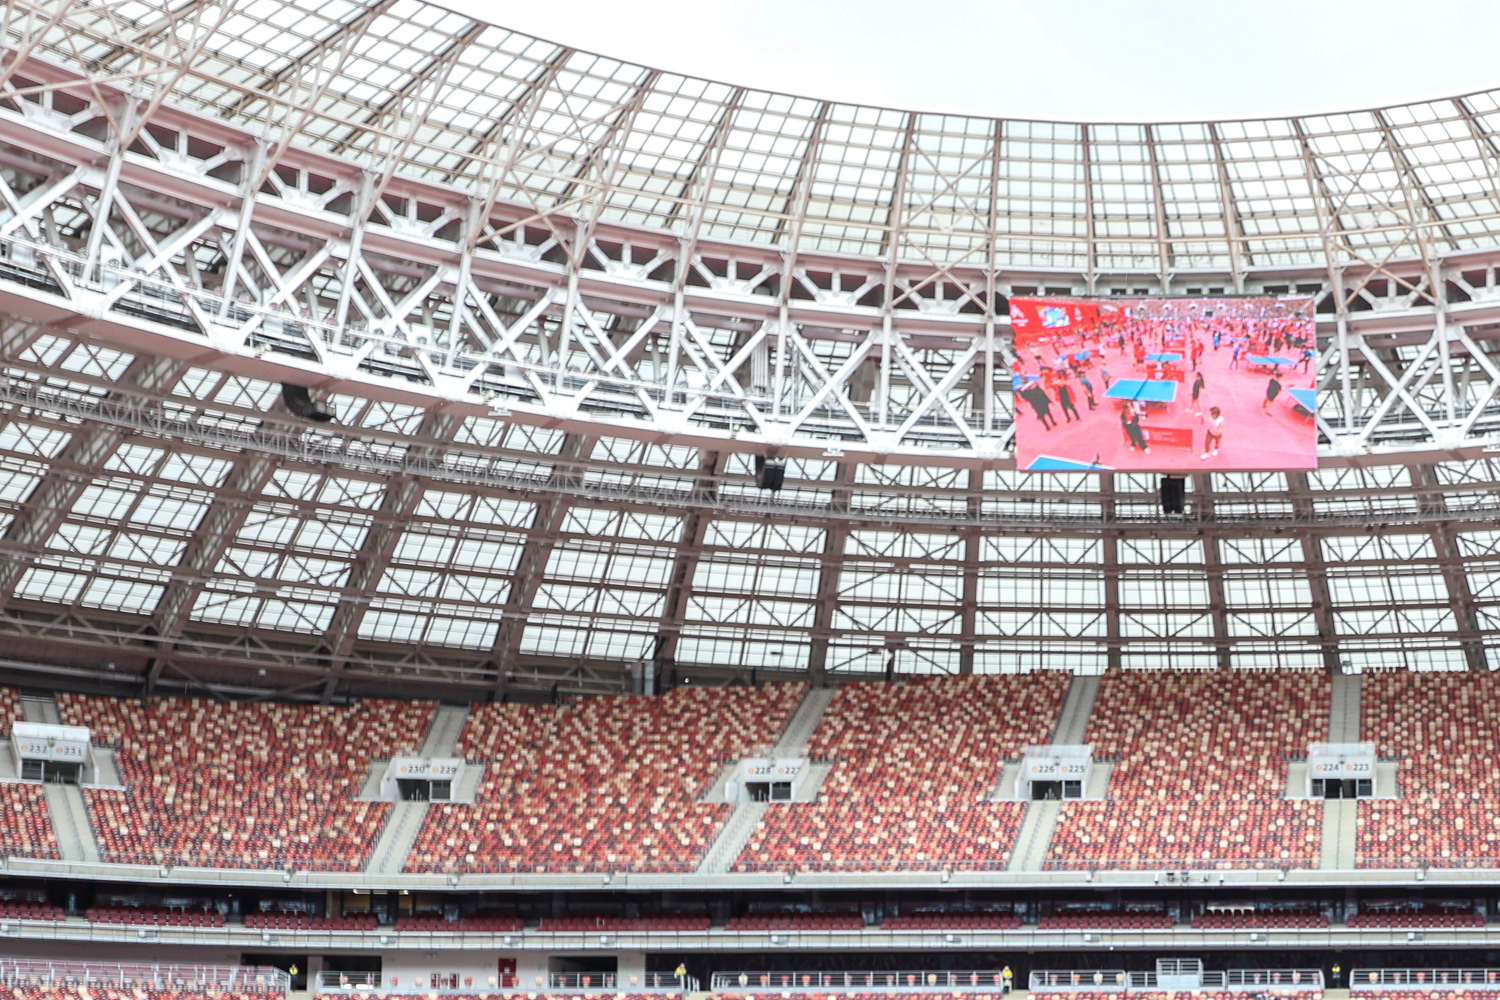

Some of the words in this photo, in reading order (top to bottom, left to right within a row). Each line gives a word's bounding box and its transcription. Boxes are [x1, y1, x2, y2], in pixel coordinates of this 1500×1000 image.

[1039, 765, 1056, 773] 226
[1069, 765, 1086, 773] 225
[1323, 763, 1340, 771] 224
[1353, 763, 1370, 771] 223
